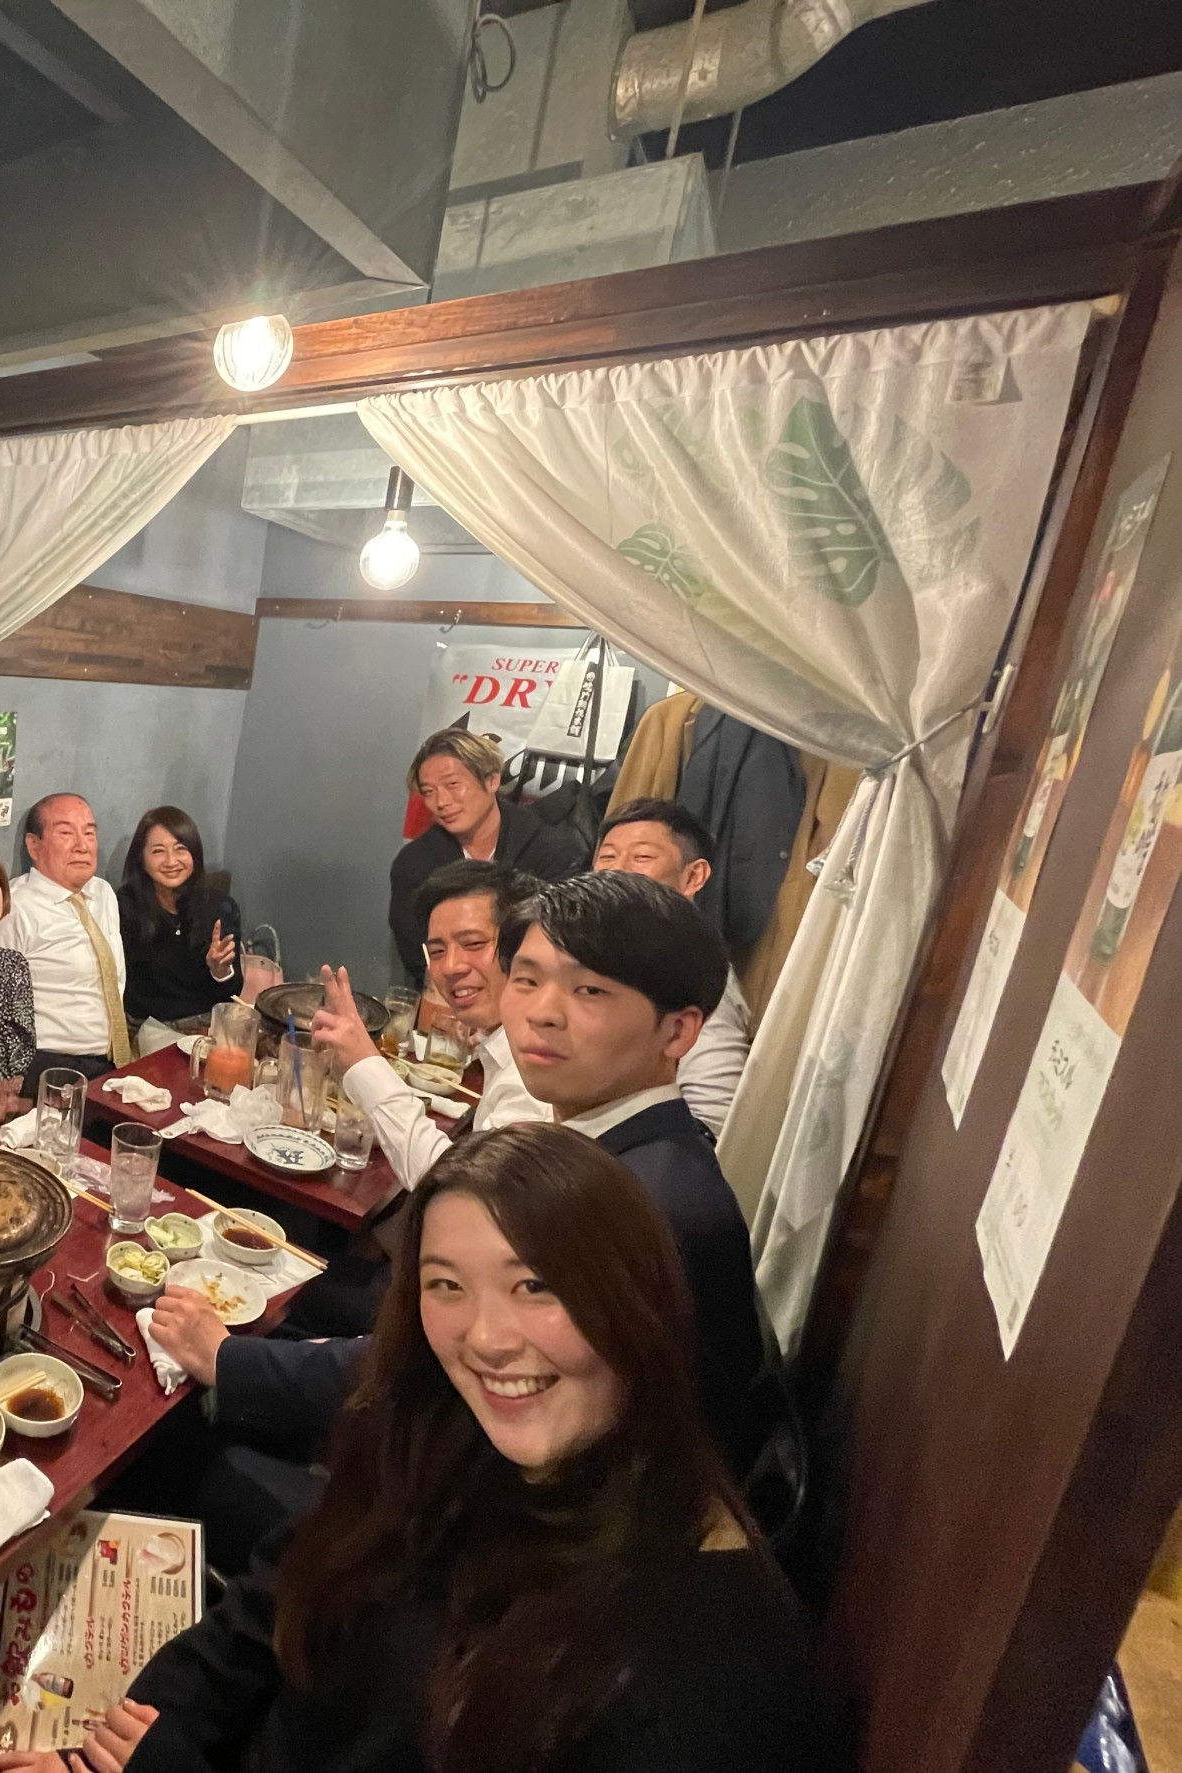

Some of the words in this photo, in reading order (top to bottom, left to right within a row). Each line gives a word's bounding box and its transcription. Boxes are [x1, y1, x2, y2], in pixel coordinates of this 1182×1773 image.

[491, 658, 560, 674] SUPER
[452, 674, 554, 709] "DR
[0, 1562, 37, 1706] お飲みもの
[84, 1616, 95, 1667] カクテル
